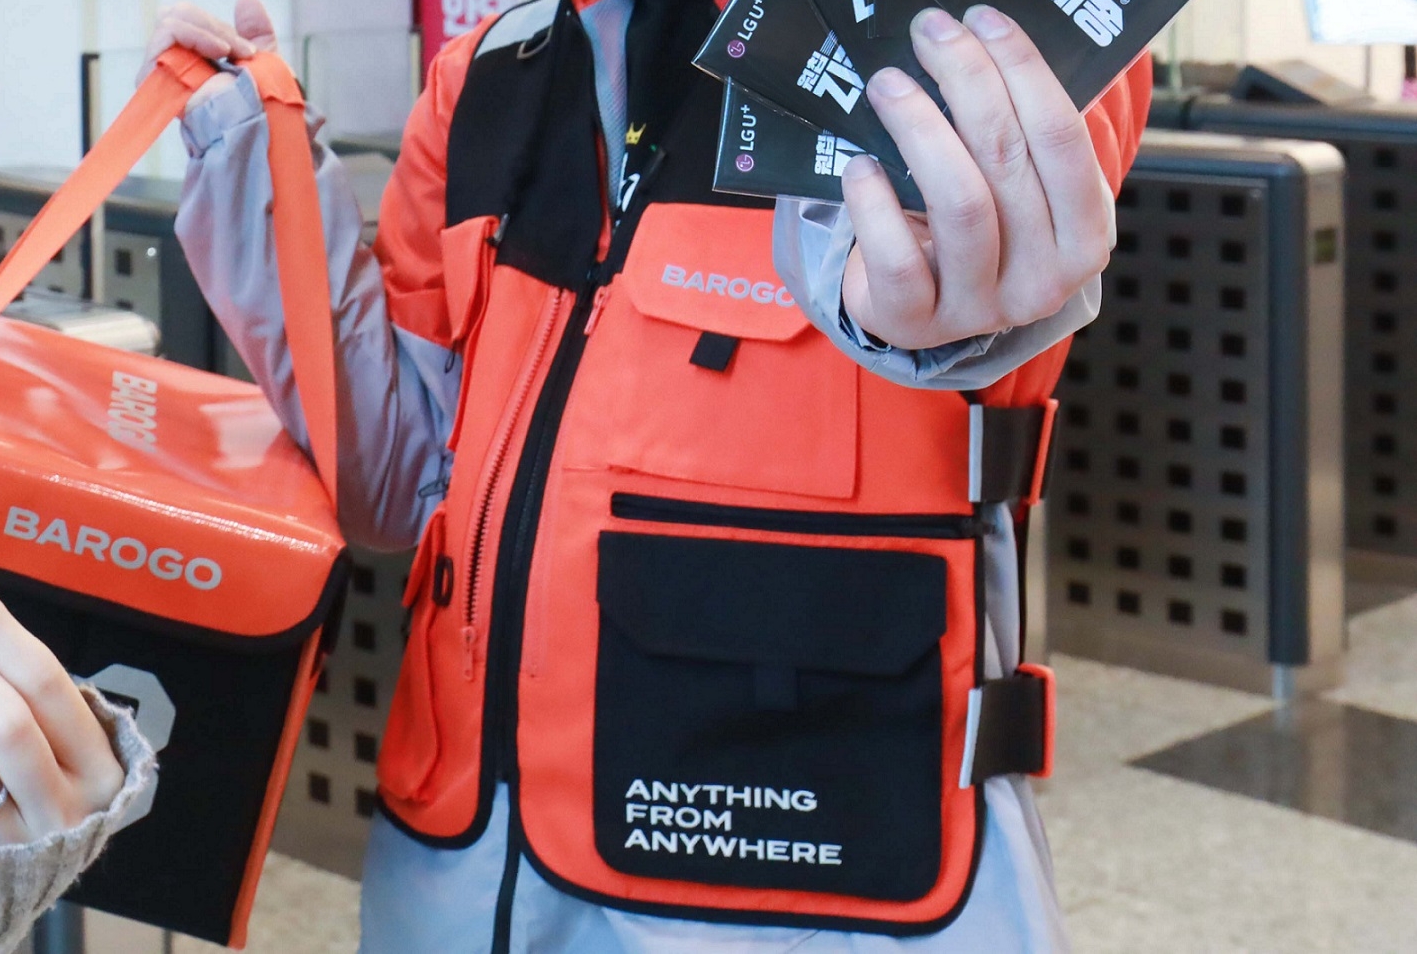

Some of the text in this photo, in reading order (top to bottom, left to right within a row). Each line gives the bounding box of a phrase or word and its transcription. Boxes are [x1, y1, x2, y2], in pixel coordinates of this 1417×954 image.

[796, 50, 829, 92] 원칩
[814, 134, 836, 175] 원칩
[3, 506, 223, 591] BAROGO
[625, 779, 818, 812] ANYTHING
[625, 803, 732, 832] FROM
[624, 829, 843, 865] ANYWHERE
